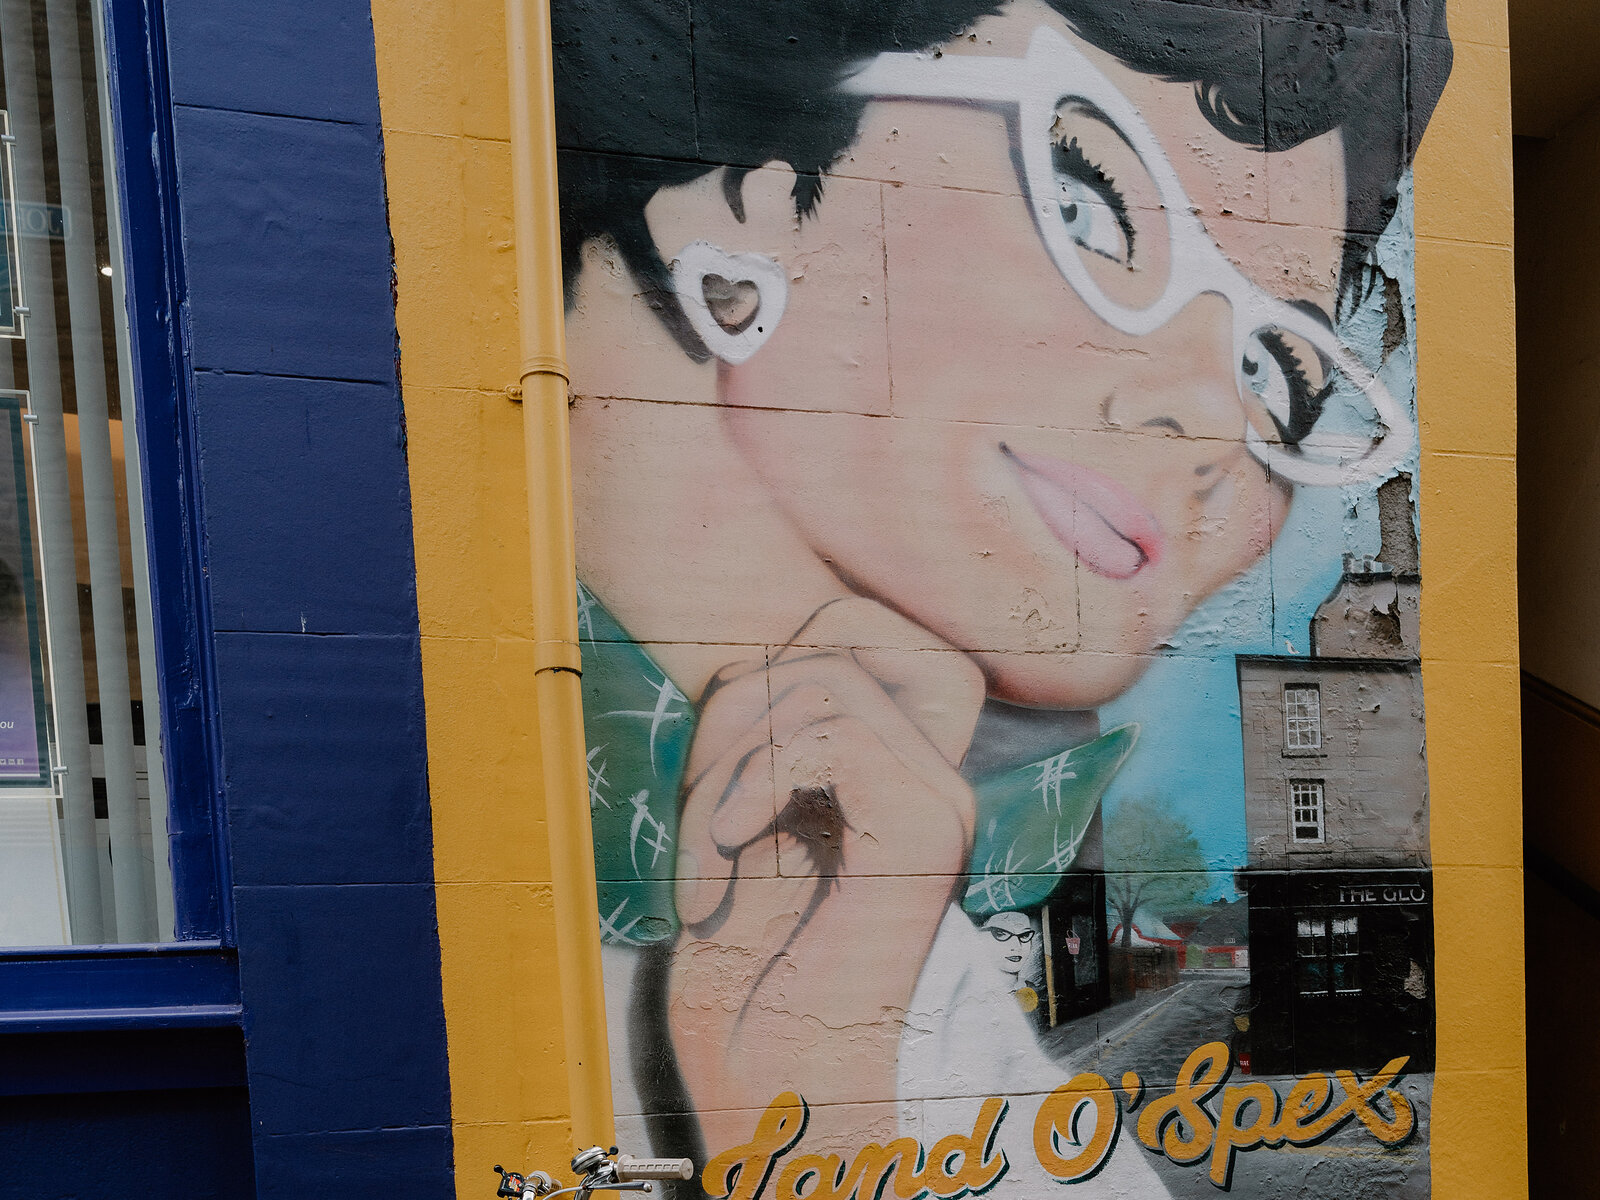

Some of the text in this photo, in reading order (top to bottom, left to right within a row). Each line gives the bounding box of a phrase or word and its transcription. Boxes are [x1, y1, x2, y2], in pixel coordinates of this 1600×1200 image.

[0, 721, 14, 729] ou
[1339, 888, 1377, 903] THE
[1033, 1041, 1418, 1191] O'Spex
